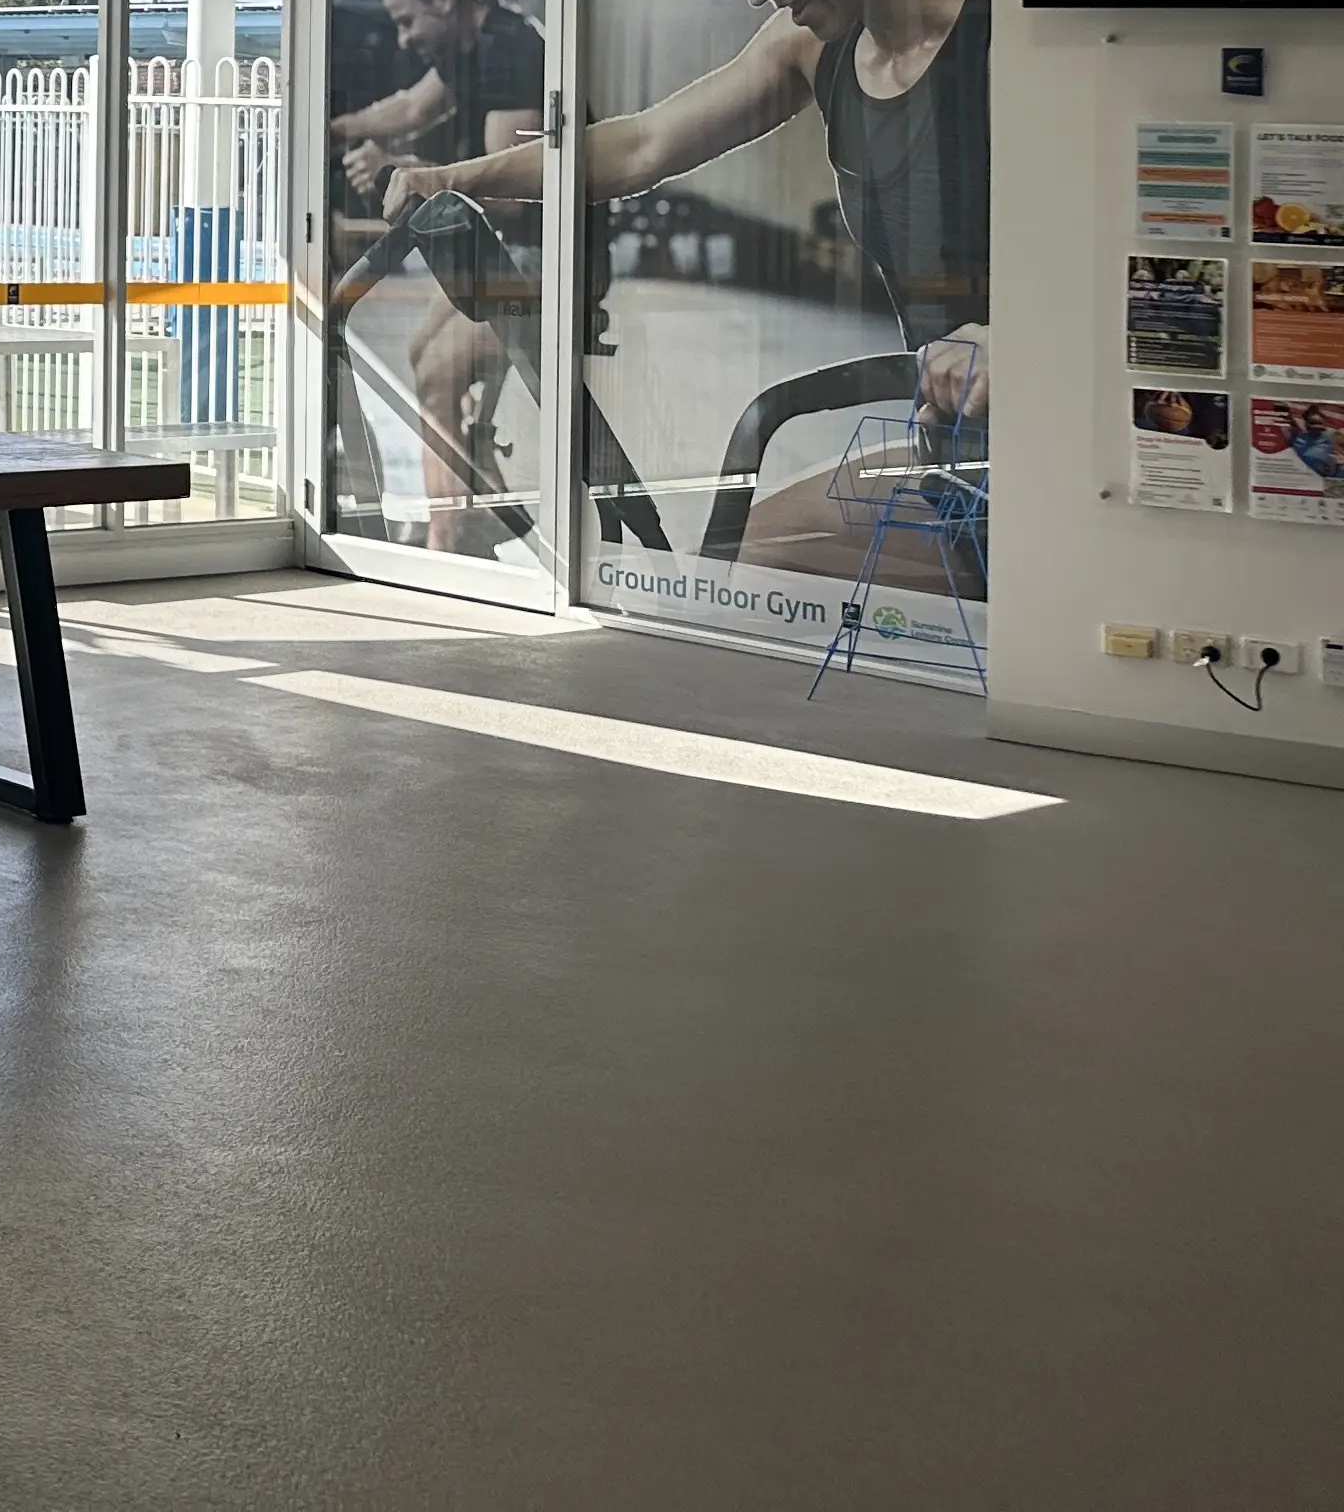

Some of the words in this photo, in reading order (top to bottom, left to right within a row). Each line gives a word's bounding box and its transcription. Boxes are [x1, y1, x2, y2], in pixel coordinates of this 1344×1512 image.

[597, 561, 688, 600] Ground
[694, 577, 761, 612] Floor
[766, 590, 827, 624] Gym
